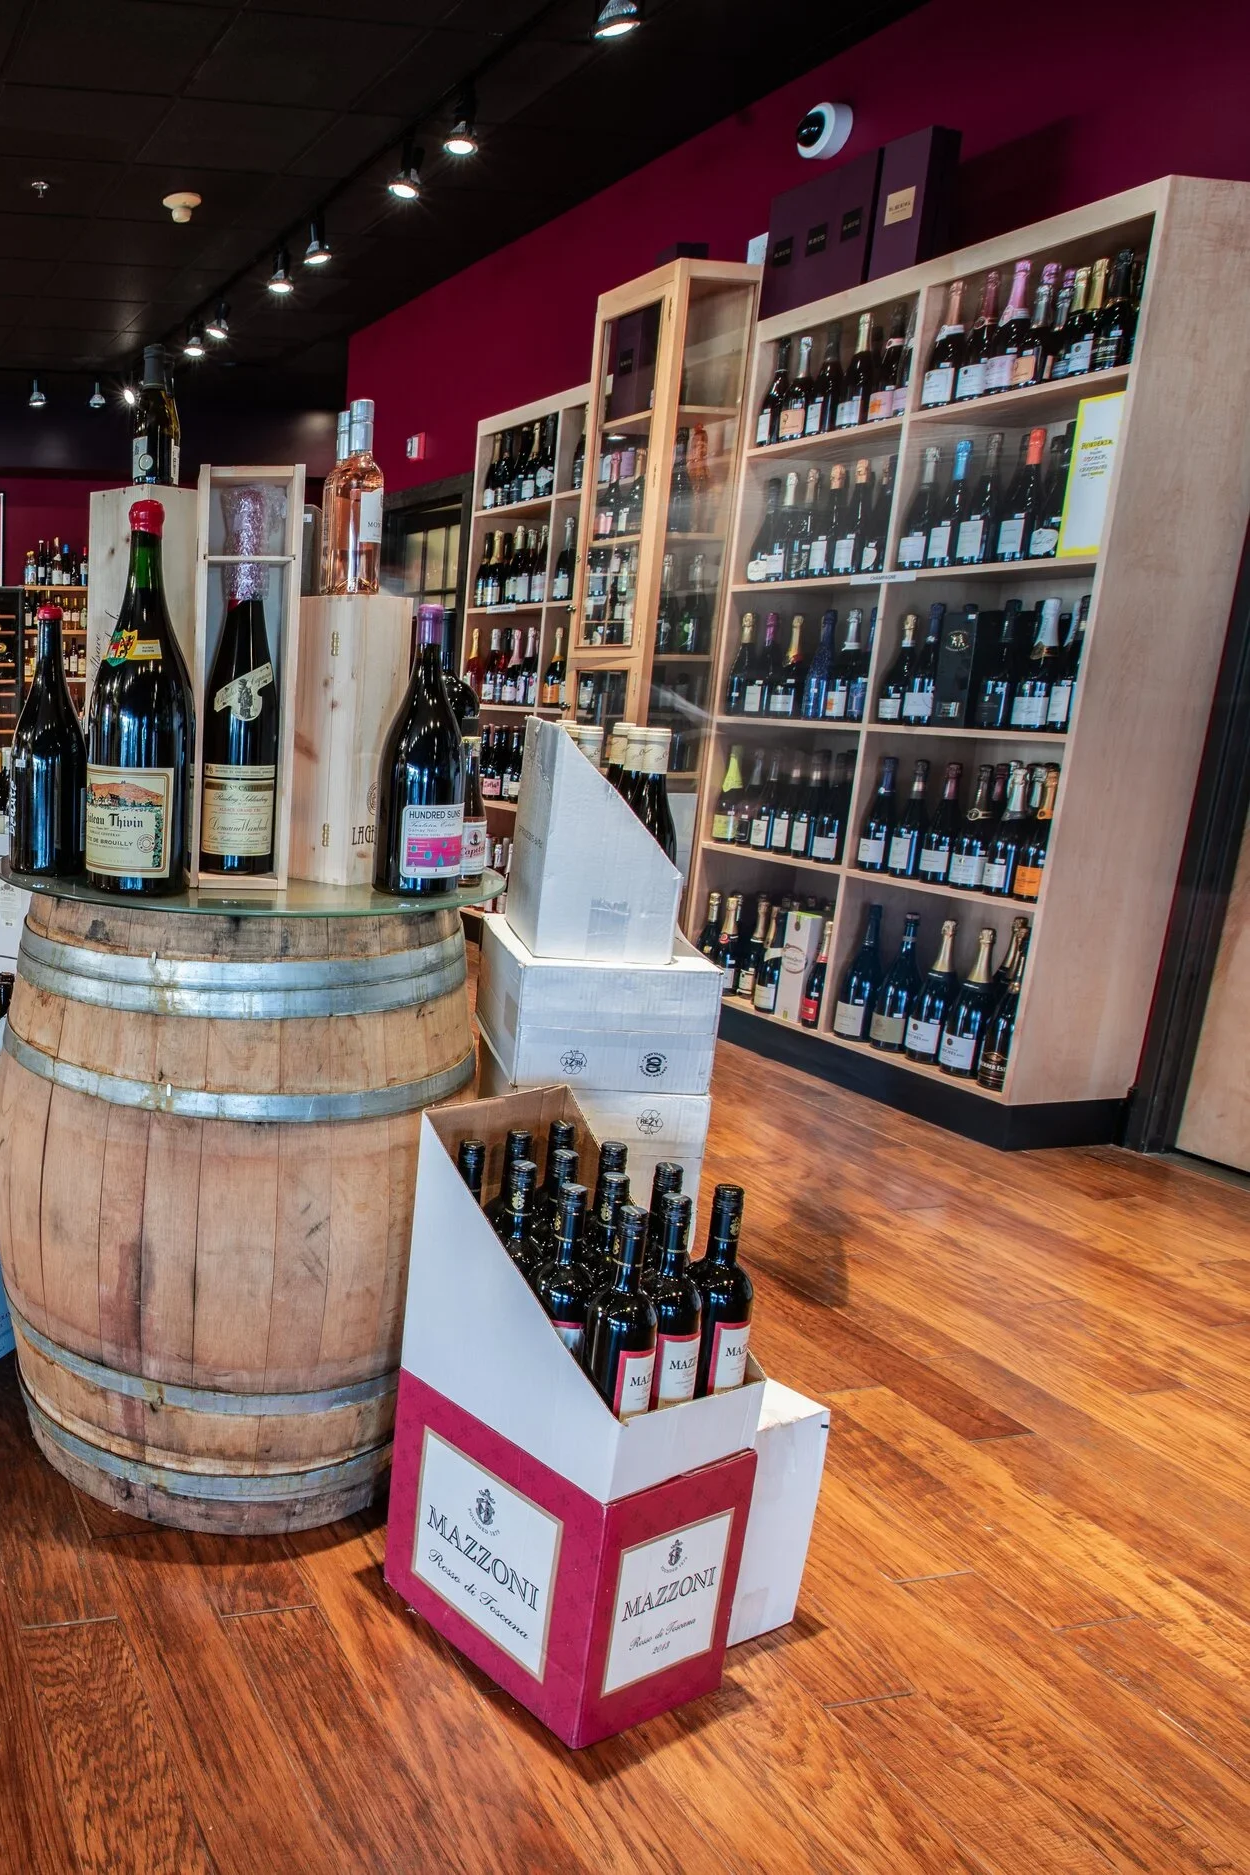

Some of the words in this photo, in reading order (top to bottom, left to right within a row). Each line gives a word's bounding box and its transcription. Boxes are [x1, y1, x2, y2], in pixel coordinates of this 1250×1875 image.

[108, 813, 144, 829] Thivin
[409, 810, 446, 820] HUNDRED
[446, 809, 461, 818] SUNS
[100, 839, 134, 847] BROUILLY
[639, 1117, 659, 1127] REZY
[426, 1504, 541, 1613] MAZZONI
[428, 1547, 462, 1585] Rosso
[464, 1580, 478, 1598] di
[479, 1591, 530, 1641] Toscana
[621, 1566, 717, 1623] MAZZONI
[628, 1635, 653, 1651] Rosso
[654, 1626, 664, 1639] di
[665, 1617, 697, 1636] Toscana
